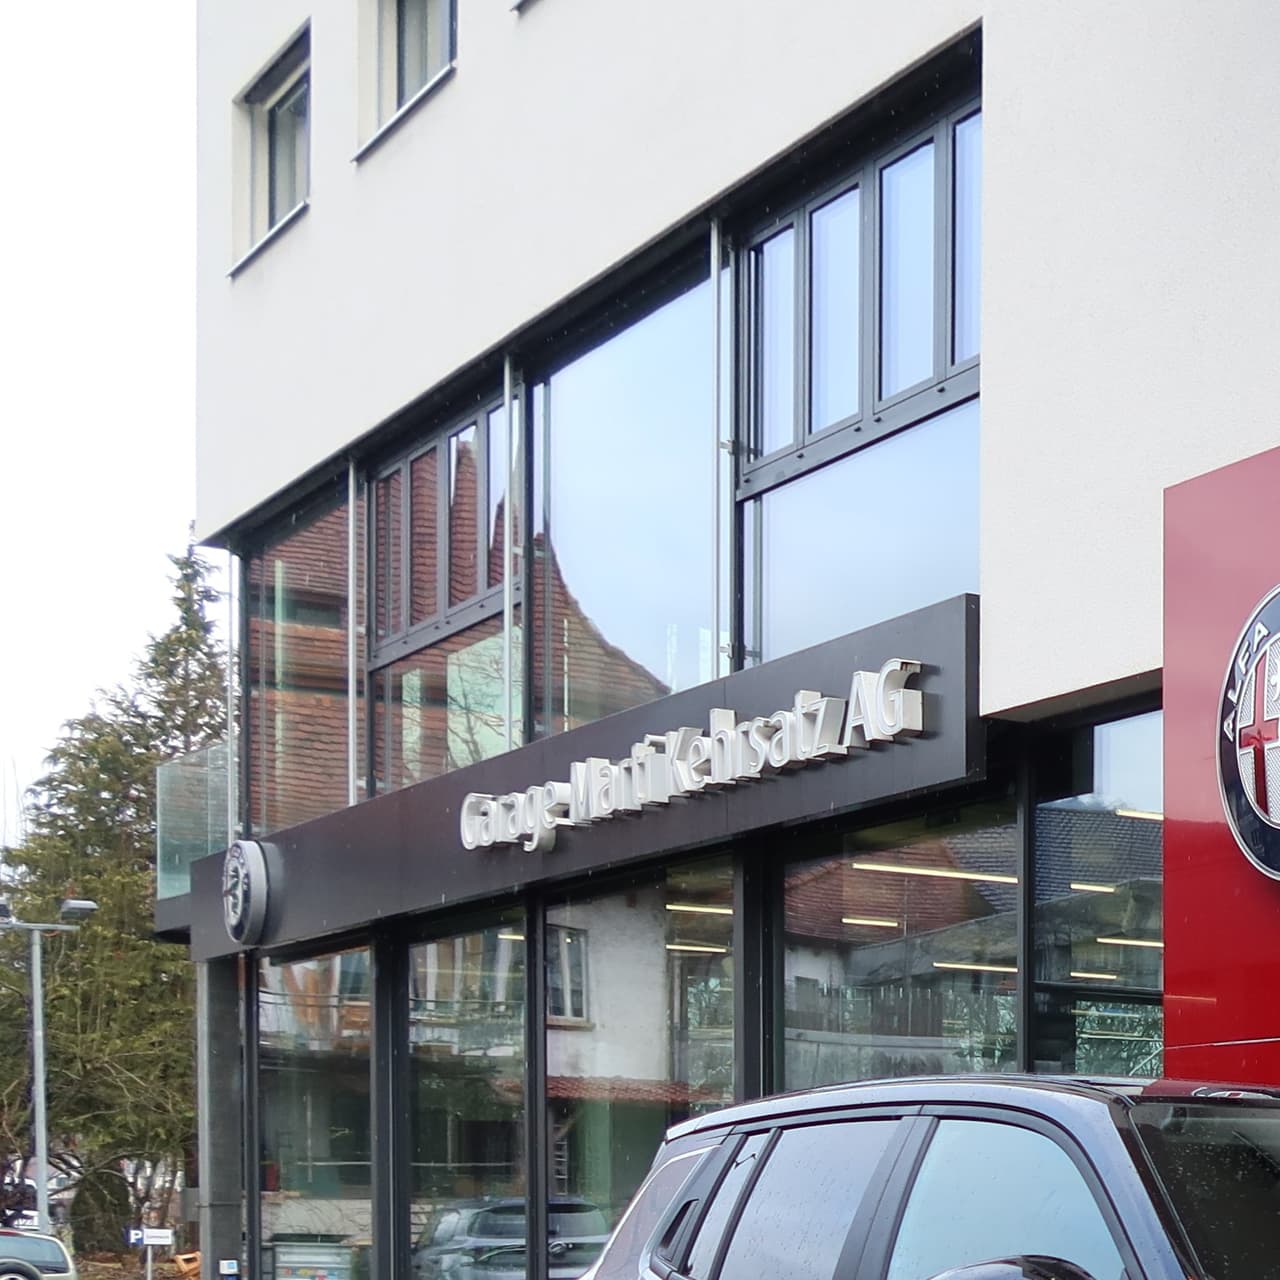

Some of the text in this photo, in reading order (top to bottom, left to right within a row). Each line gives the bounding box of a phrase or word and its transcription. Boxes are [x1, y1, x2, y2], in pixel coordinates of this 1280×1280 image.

[1223, 621, 1270, 742] ALFA
[460, 779, 568, 853] Garage
[666, 690, 848, 796] Kehrsatz
[844, 658, 922, 749] AG
[130, 1229, 143, 1243] P
